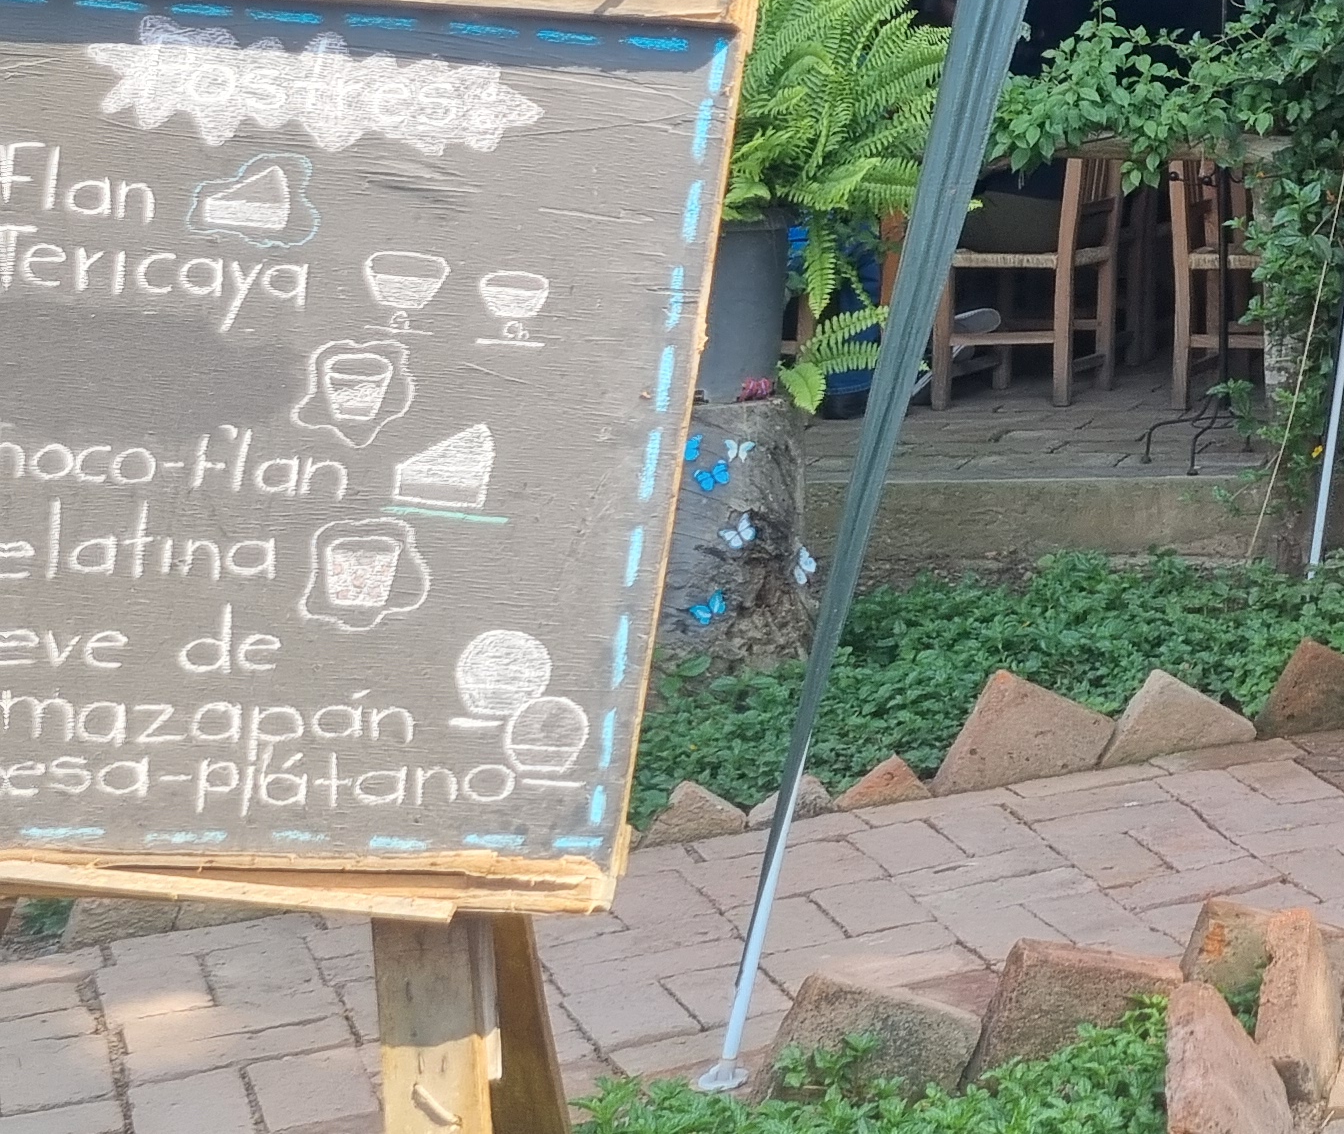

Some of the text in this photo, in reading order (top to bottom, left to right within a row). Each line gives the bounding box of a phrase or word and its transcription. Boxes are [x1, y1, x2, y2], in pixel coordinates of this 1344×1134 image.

[0, 141, 156, 224] Flan
[179, 602, 283, 674] de
[2, 688, 415, 763] mazapán
